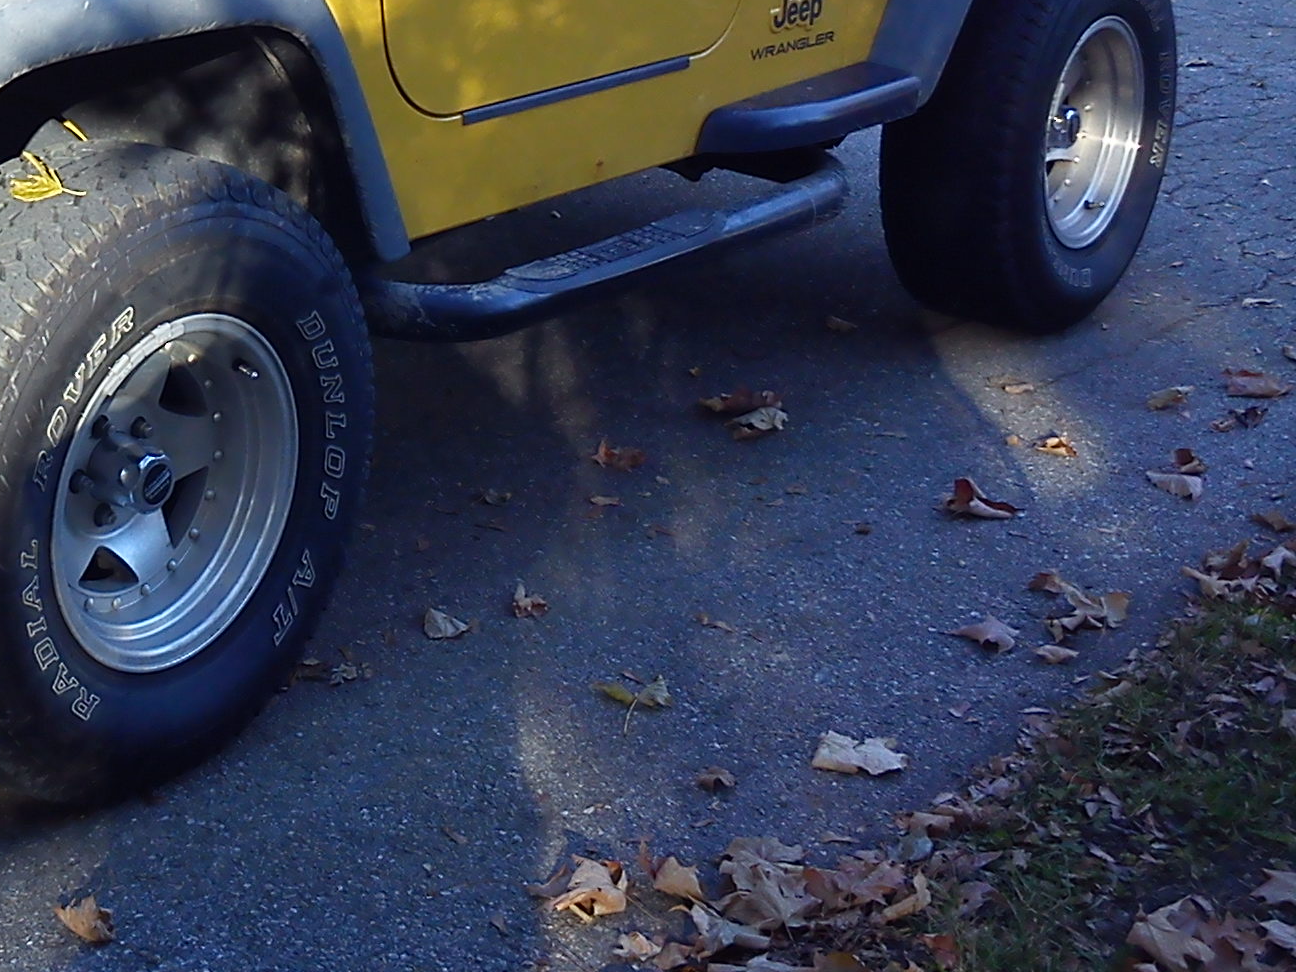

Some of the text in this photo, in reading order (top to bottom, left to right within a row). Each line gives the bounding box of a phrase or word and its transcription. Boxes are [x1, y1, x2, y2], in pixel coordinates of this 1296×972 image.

[750, 31, 835, 61] WRANGLER
[32, 306, 135, 492] ROVER
[272, 309, 348, 647] DUNLOP A/T
[20, 539, 101, 721] RADIAL
